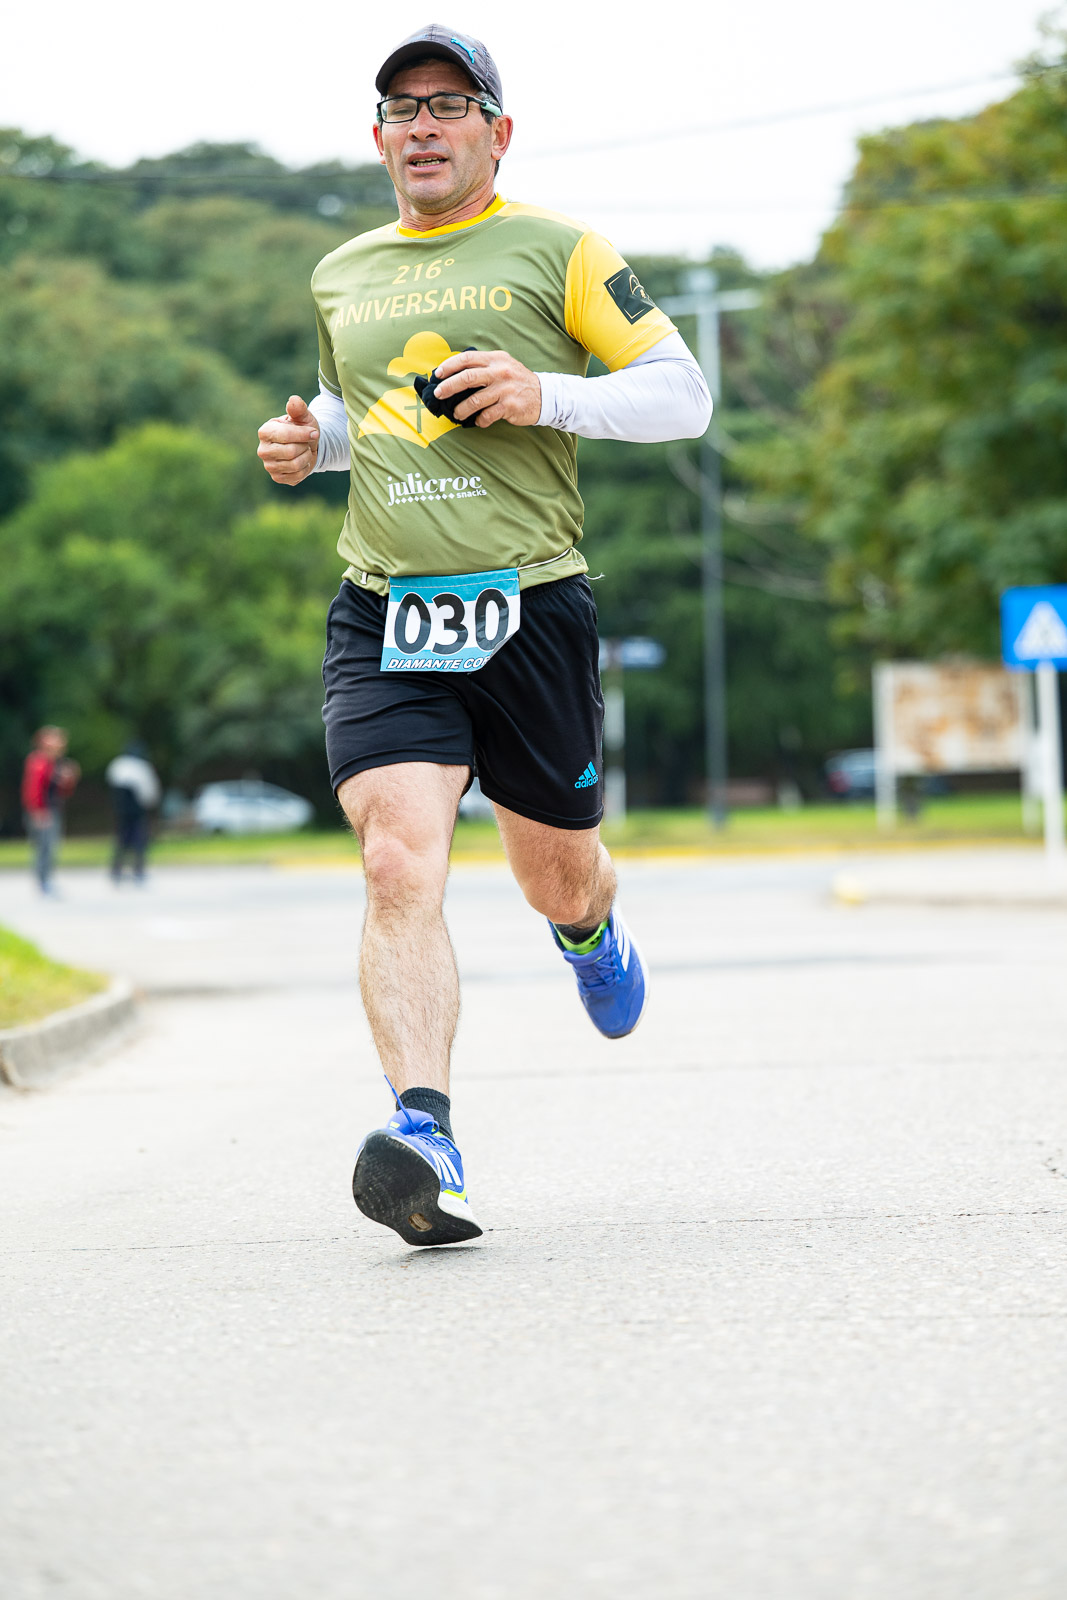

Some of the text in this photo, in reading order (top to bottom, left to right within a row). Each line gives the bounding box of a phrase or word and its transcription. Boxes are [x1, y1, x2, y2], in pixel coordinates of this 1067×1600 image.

[334, 285, 513, 331] ANIVERSARIO
[387, 472, 482, 506] julicroc
[456, 488, 487, 499] snacks
[394, 588, 509, 655] 030
[386, 658, 462, 670] DIAMANTE
